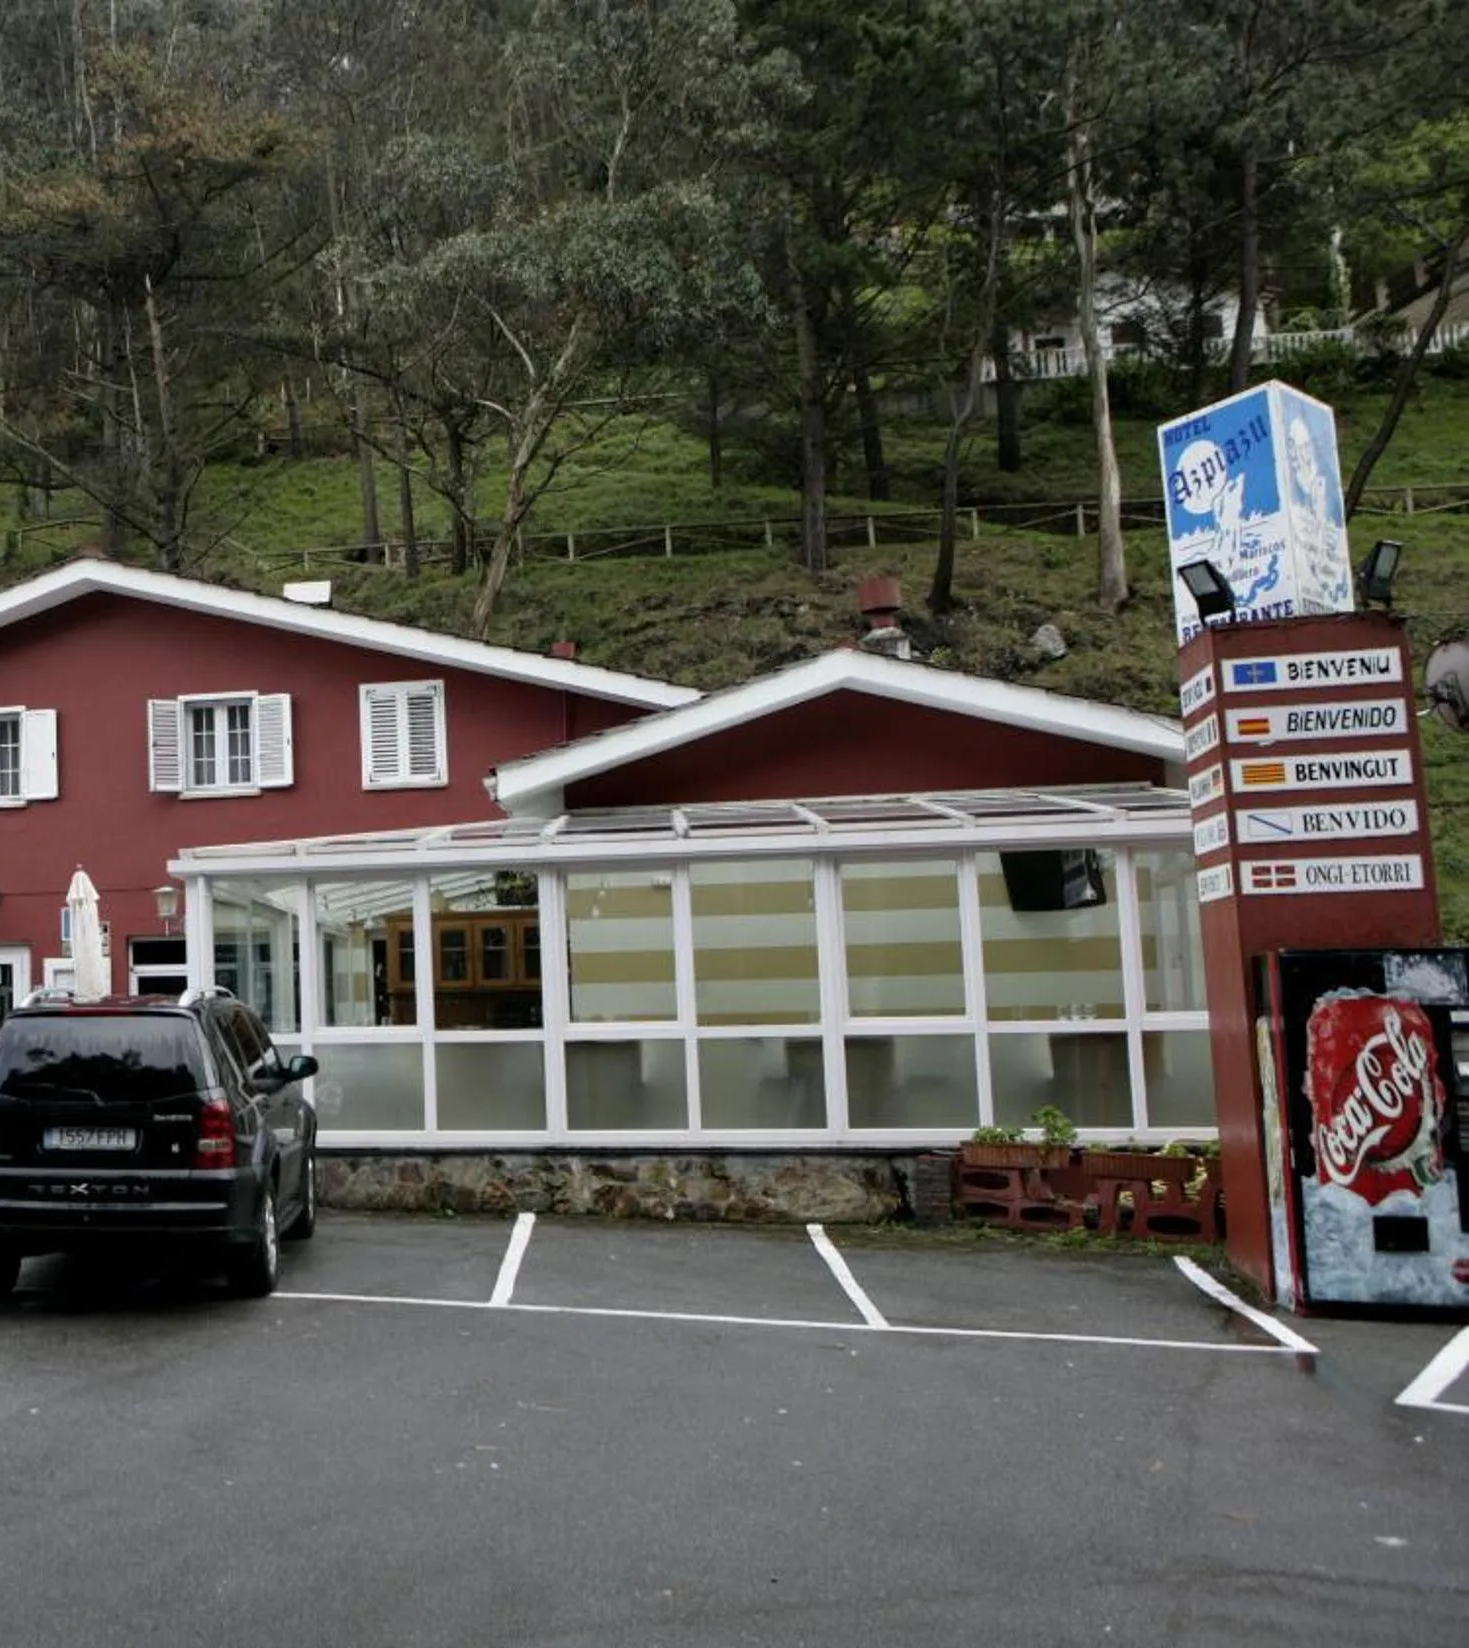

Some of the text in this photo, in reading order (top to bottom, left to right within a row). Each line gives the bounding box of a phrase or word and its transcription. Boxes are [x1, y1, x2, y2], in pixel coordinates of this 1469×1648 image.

[1163, 414, 1211, 443] HOTEL
[1295, 758, 1399, 782] BENVINGUT
[1302, 808, 1406, 833] BENVIDO
[1305, 862, 1412, 885] ONGI-ETORRI
